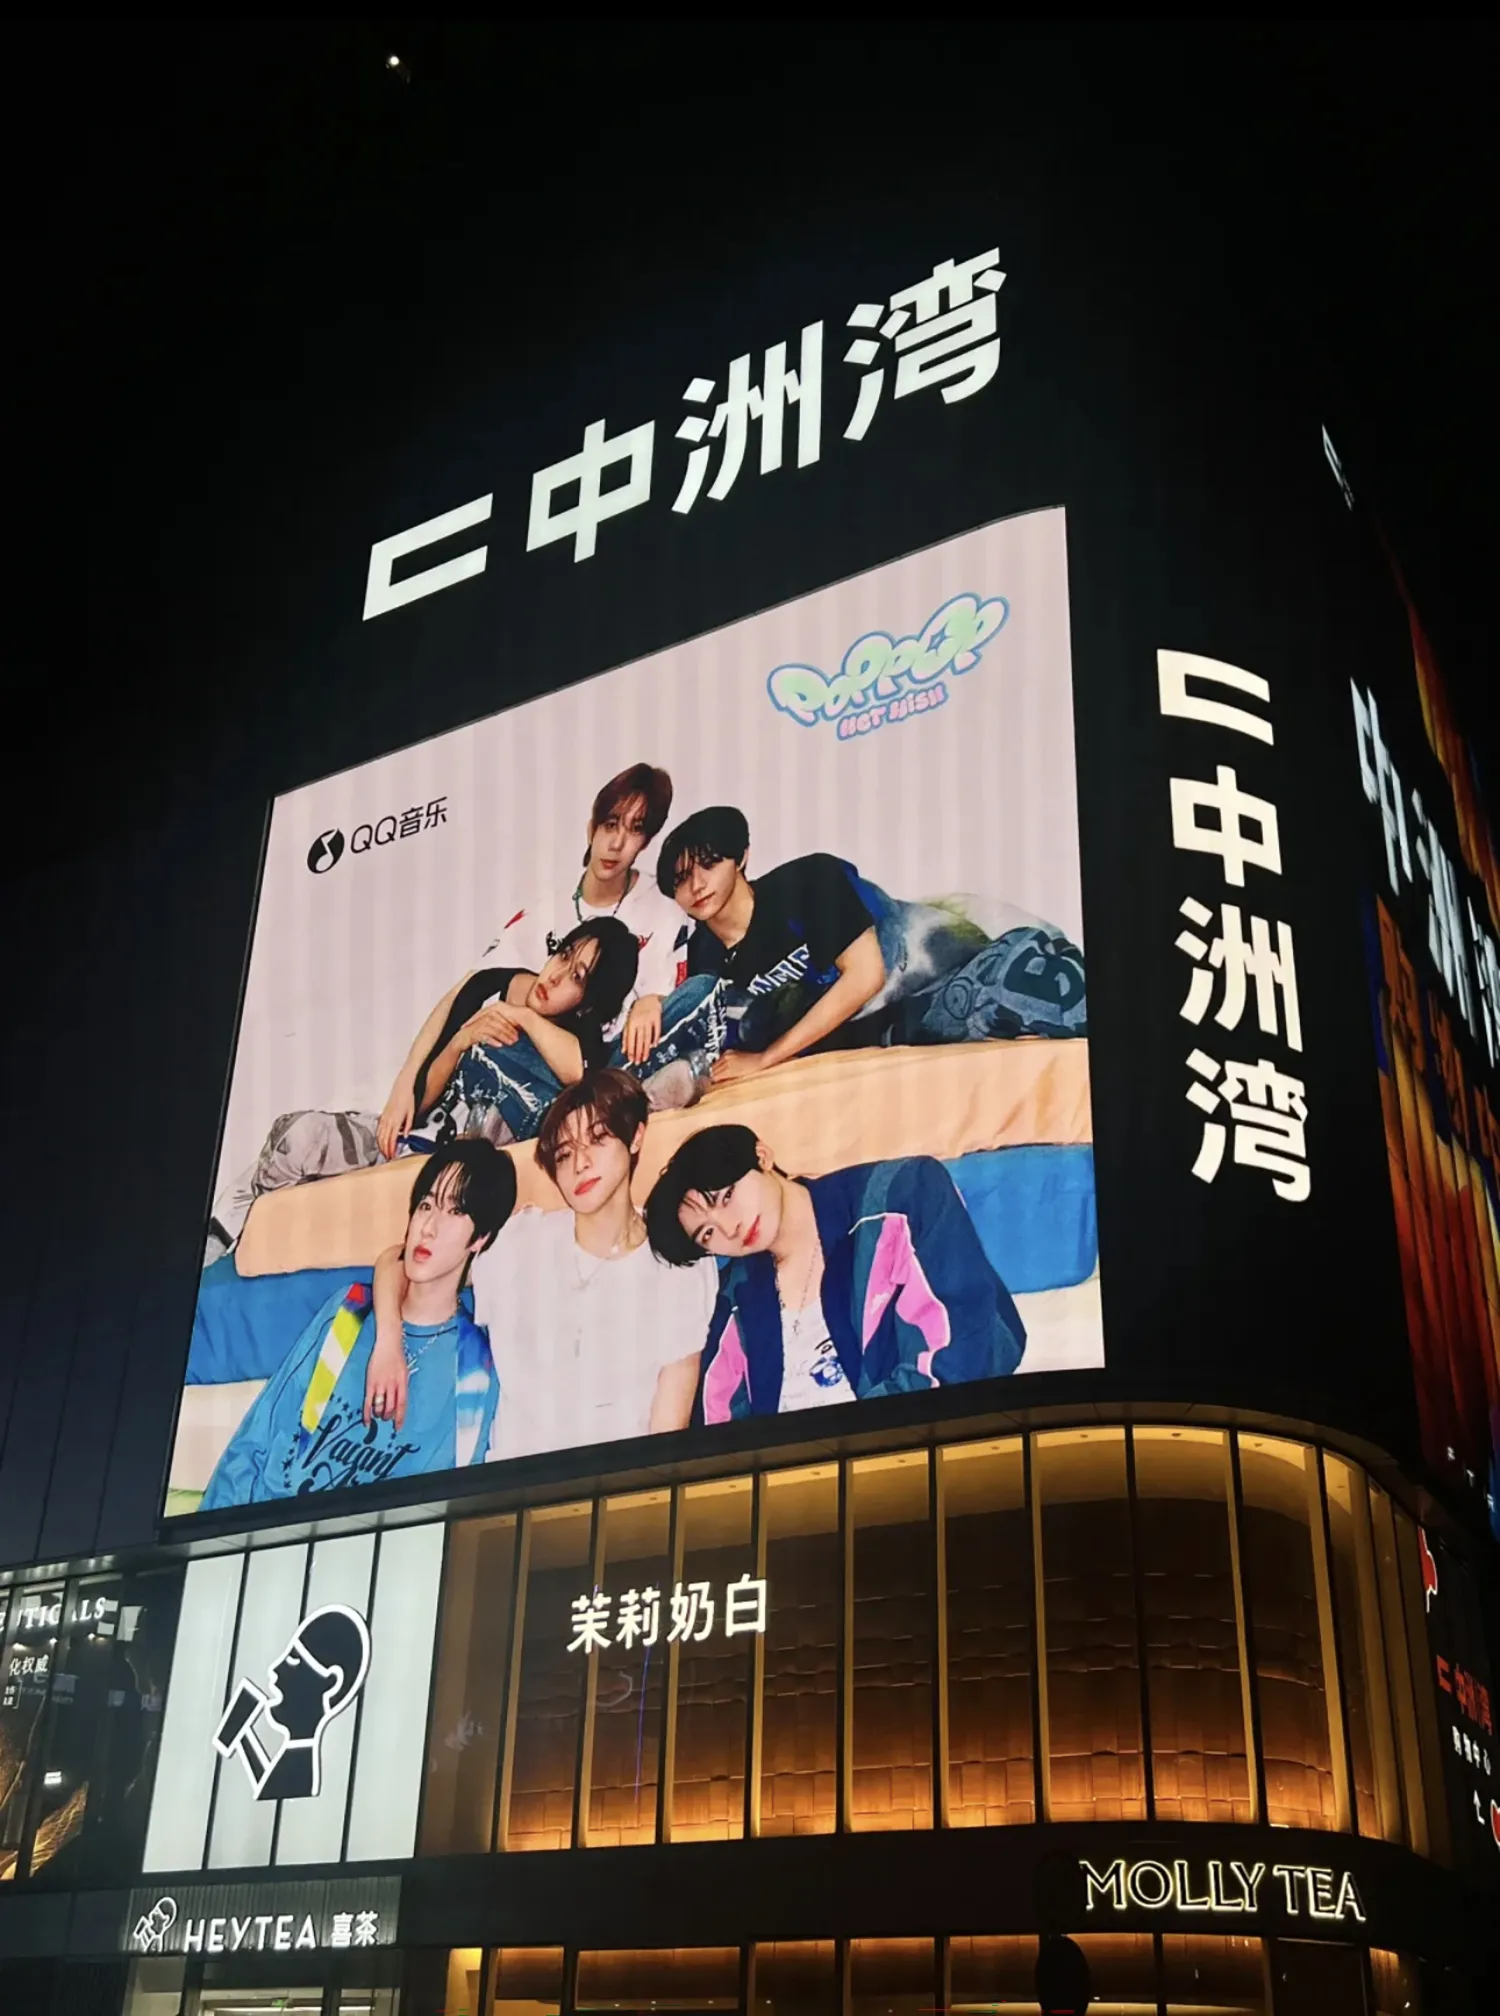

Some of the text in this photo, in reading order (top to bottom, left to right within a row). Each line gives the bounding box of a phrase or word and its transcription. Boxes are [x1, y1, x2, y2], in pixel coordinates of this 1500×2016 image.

[350, 796, 448, 854] QQ音乐
[566, 1573, 767, 1655] 茉莉奶白
[1079, 1860, 1367, 1922] MOLLY TEA
[183, 1914, 317, 1953] HEYTEA
[331, 1911, 378, 1949] 喜茶
